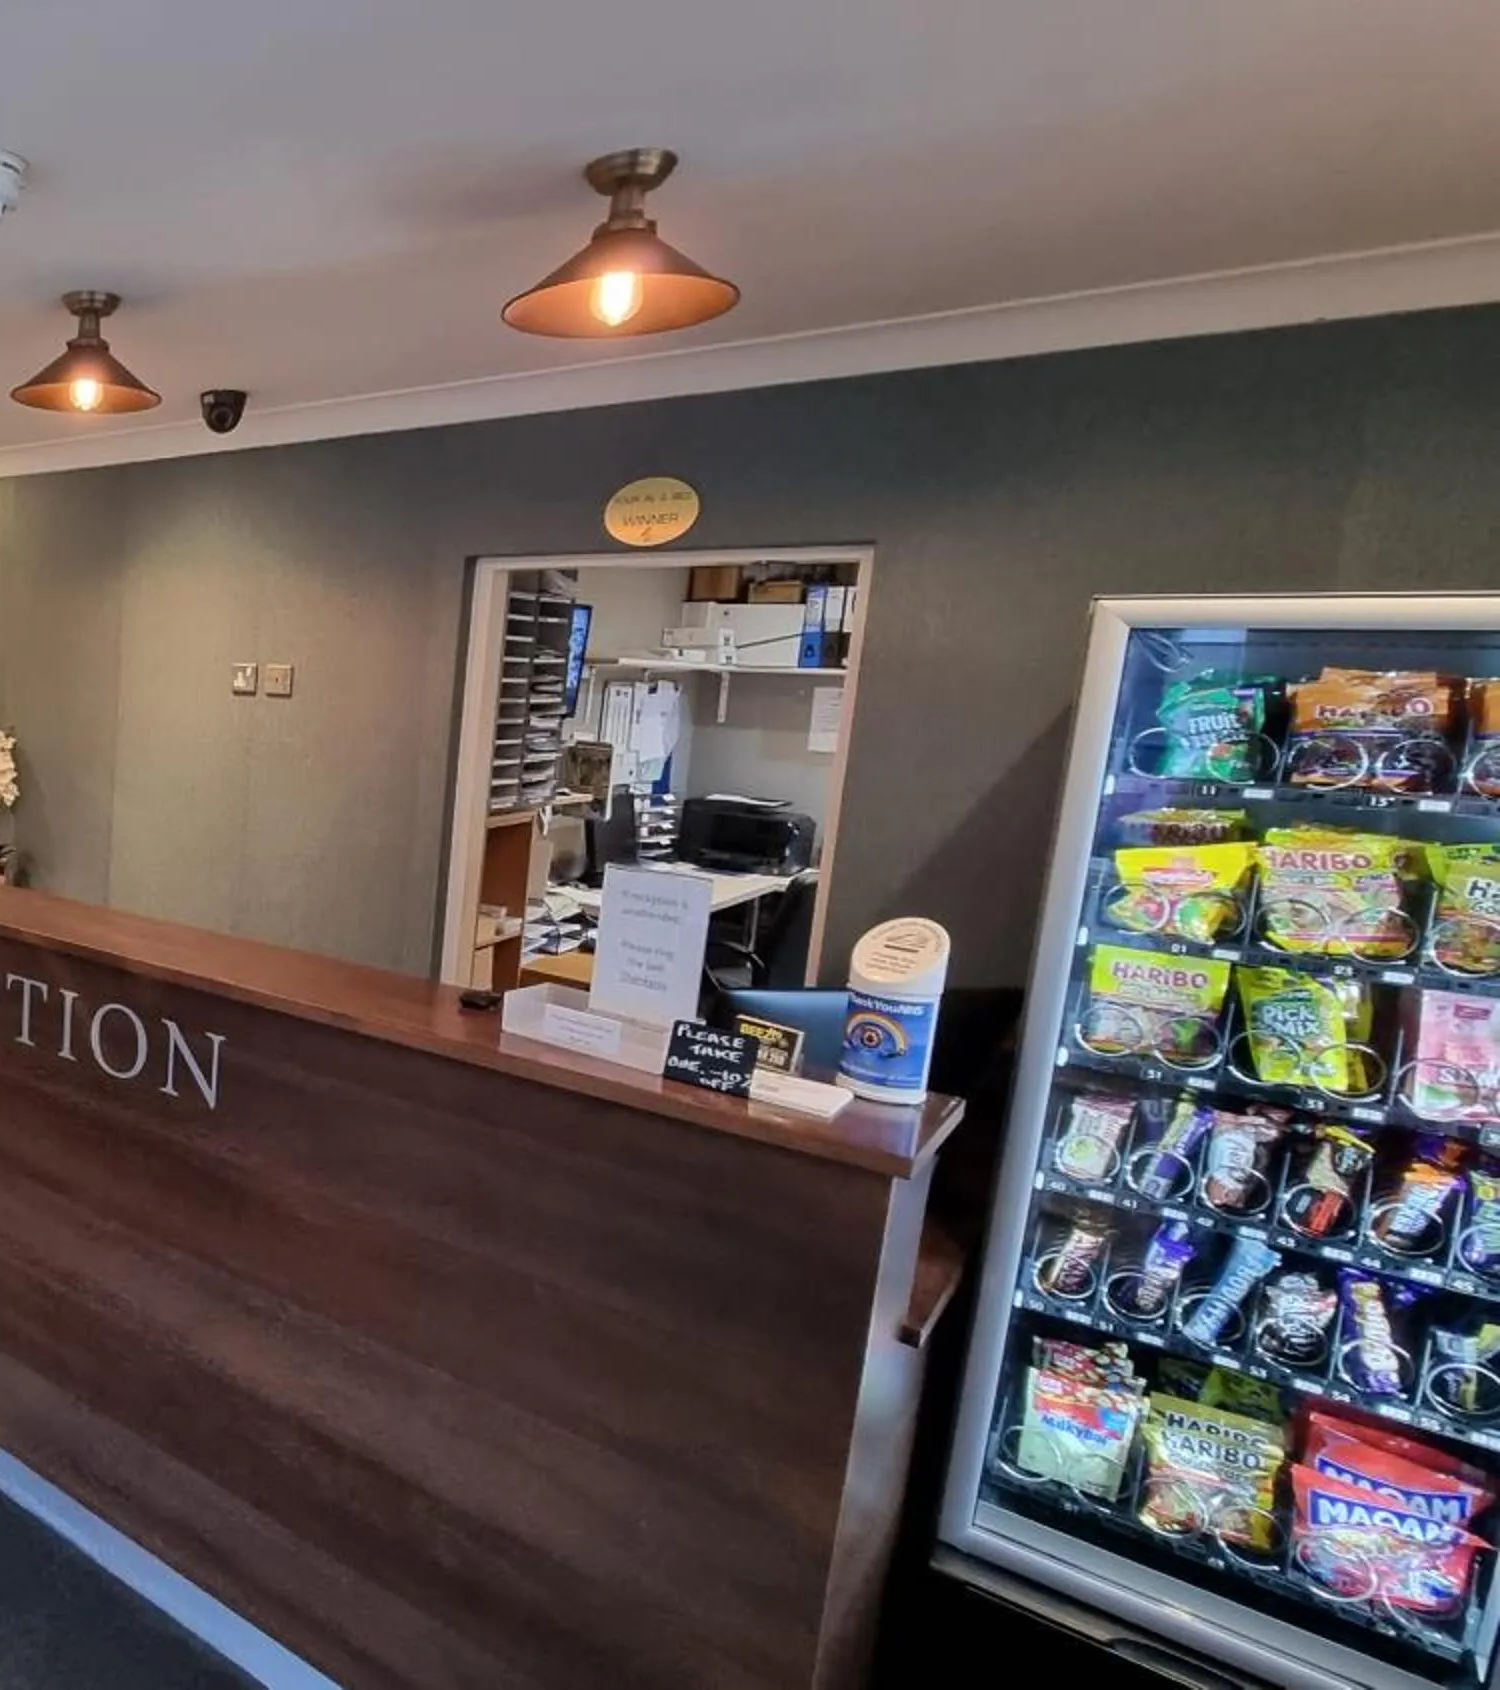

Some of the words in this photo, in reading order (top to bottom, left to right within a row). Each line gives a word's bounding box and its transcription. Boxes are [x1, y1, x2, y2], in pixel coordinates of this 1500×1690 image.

[1111, 960, 1209, 990] HARIBO
[677, 1023, 745, 1049] PLEASE
[688, 1043, 743, 1064] TAKE
